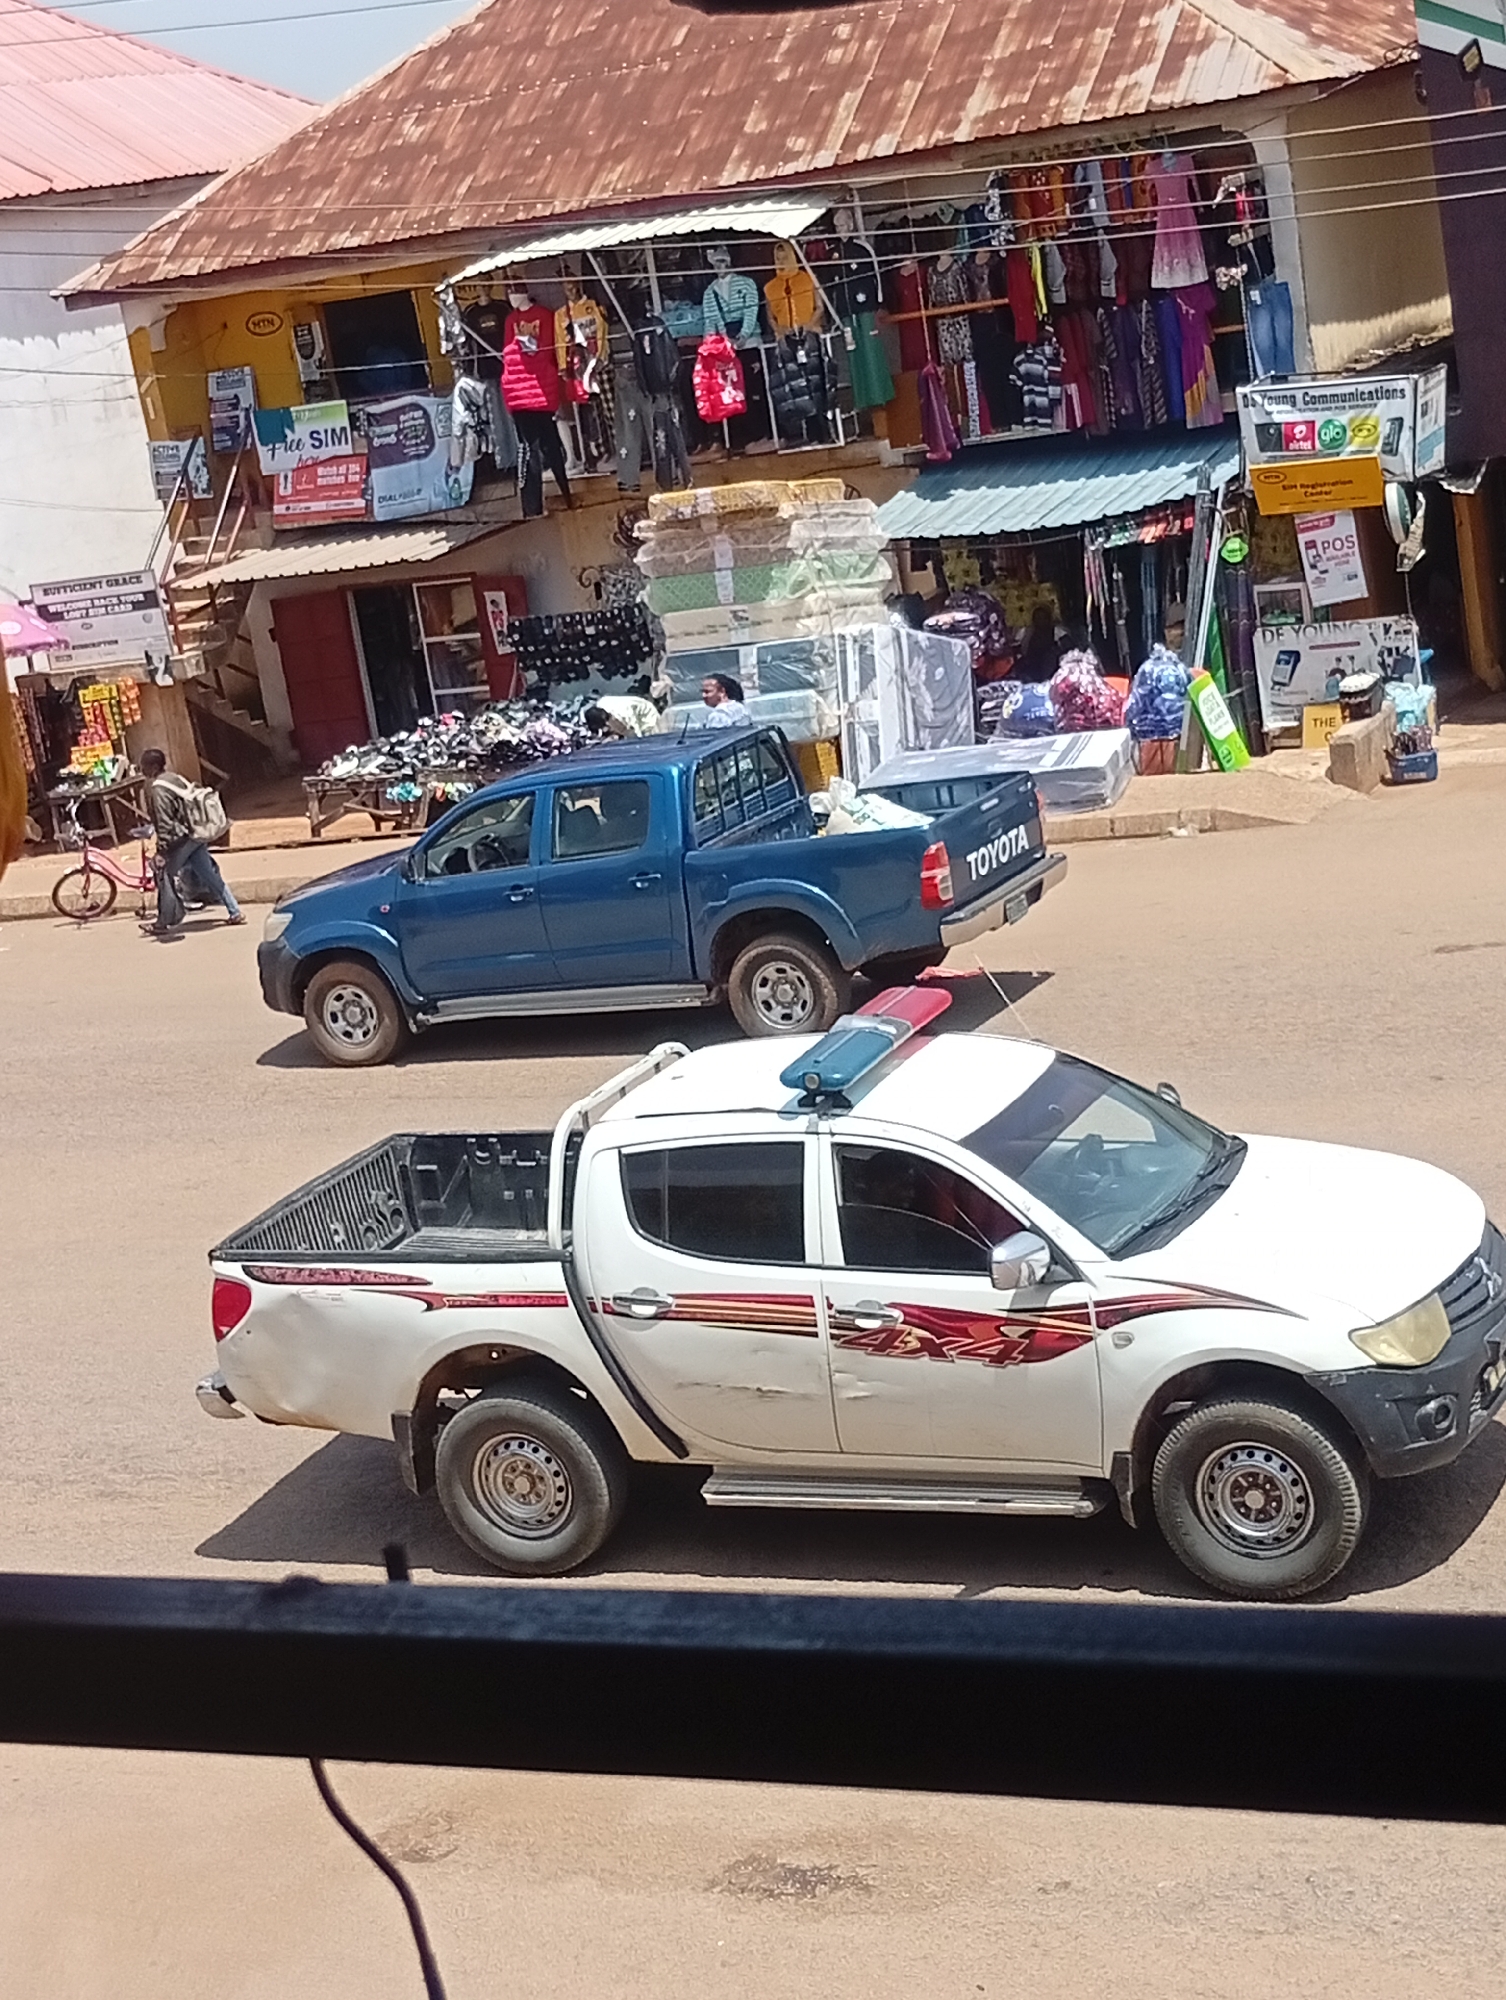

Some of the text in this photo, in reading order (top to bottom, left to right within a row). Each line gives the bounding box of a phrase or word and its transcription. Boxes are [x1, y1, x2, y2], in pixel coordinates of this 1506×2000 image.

[251, 318, 275, 330] MTN
[1260, 391, 1297, 408] Young
[1303, 385, 1406, 406] Communications
[309, 426, 349, 449] SIM
[1320, 425, 1342, 442] glo
[1289, 440, 1312, 450] airtel
[1281, 479, 1353, 491] SIM Registration
[1304, 490, 1332, 498] Center
[1321, 534, 1355, 555] POS
[106, 575, 143, 588] GRACE
[47, 599, 93, 613] WELCOME
[107, 603, 133, 613] CARD
[1262, 627, 1285, 644] DE
[1312, 717, 1336, 728] THE
[966, 824, 1029, 881] TOYOTA
